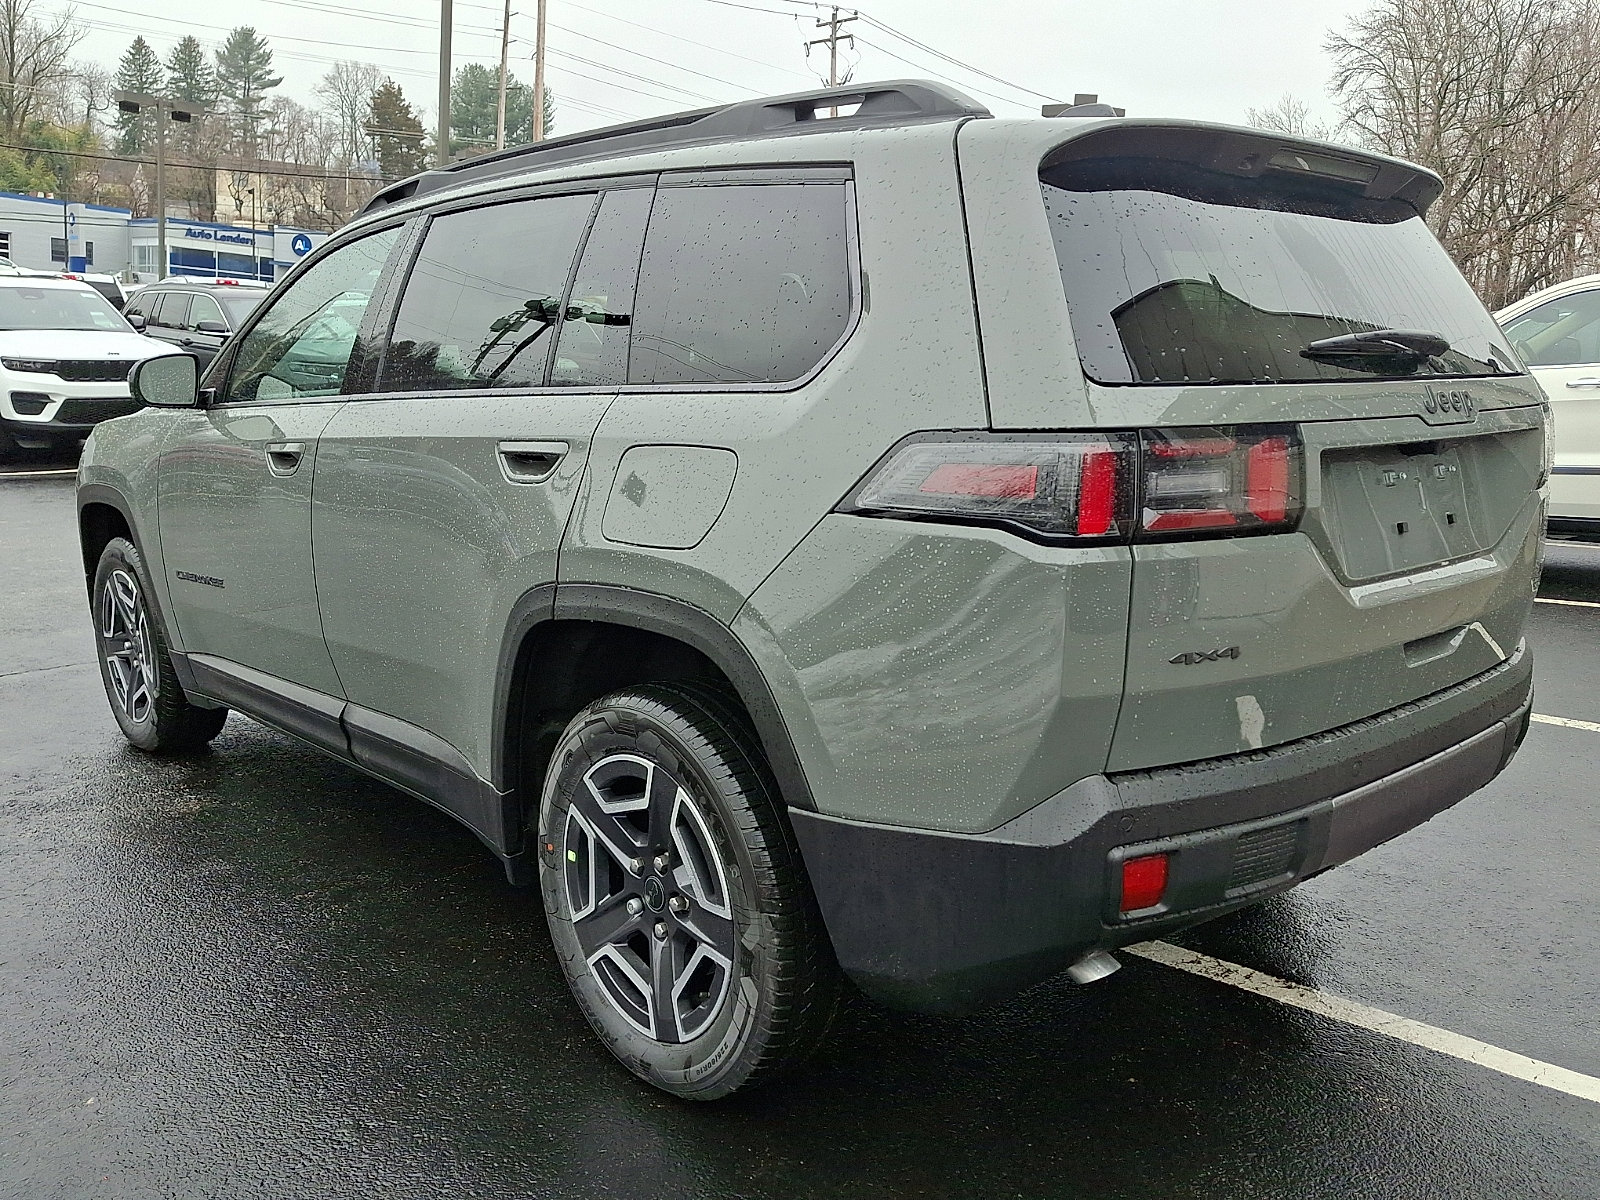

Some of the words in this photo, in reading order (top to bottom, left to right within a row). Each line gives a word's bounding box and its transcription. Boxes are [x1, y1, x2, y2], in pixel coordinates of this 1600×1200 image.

[185, 227, 212, 240] Auto
[294, 239, 309, 251] AL
[1423, 384, 1474, 417] Jeep
[176, 570, 225, 589] CHEROKEE
